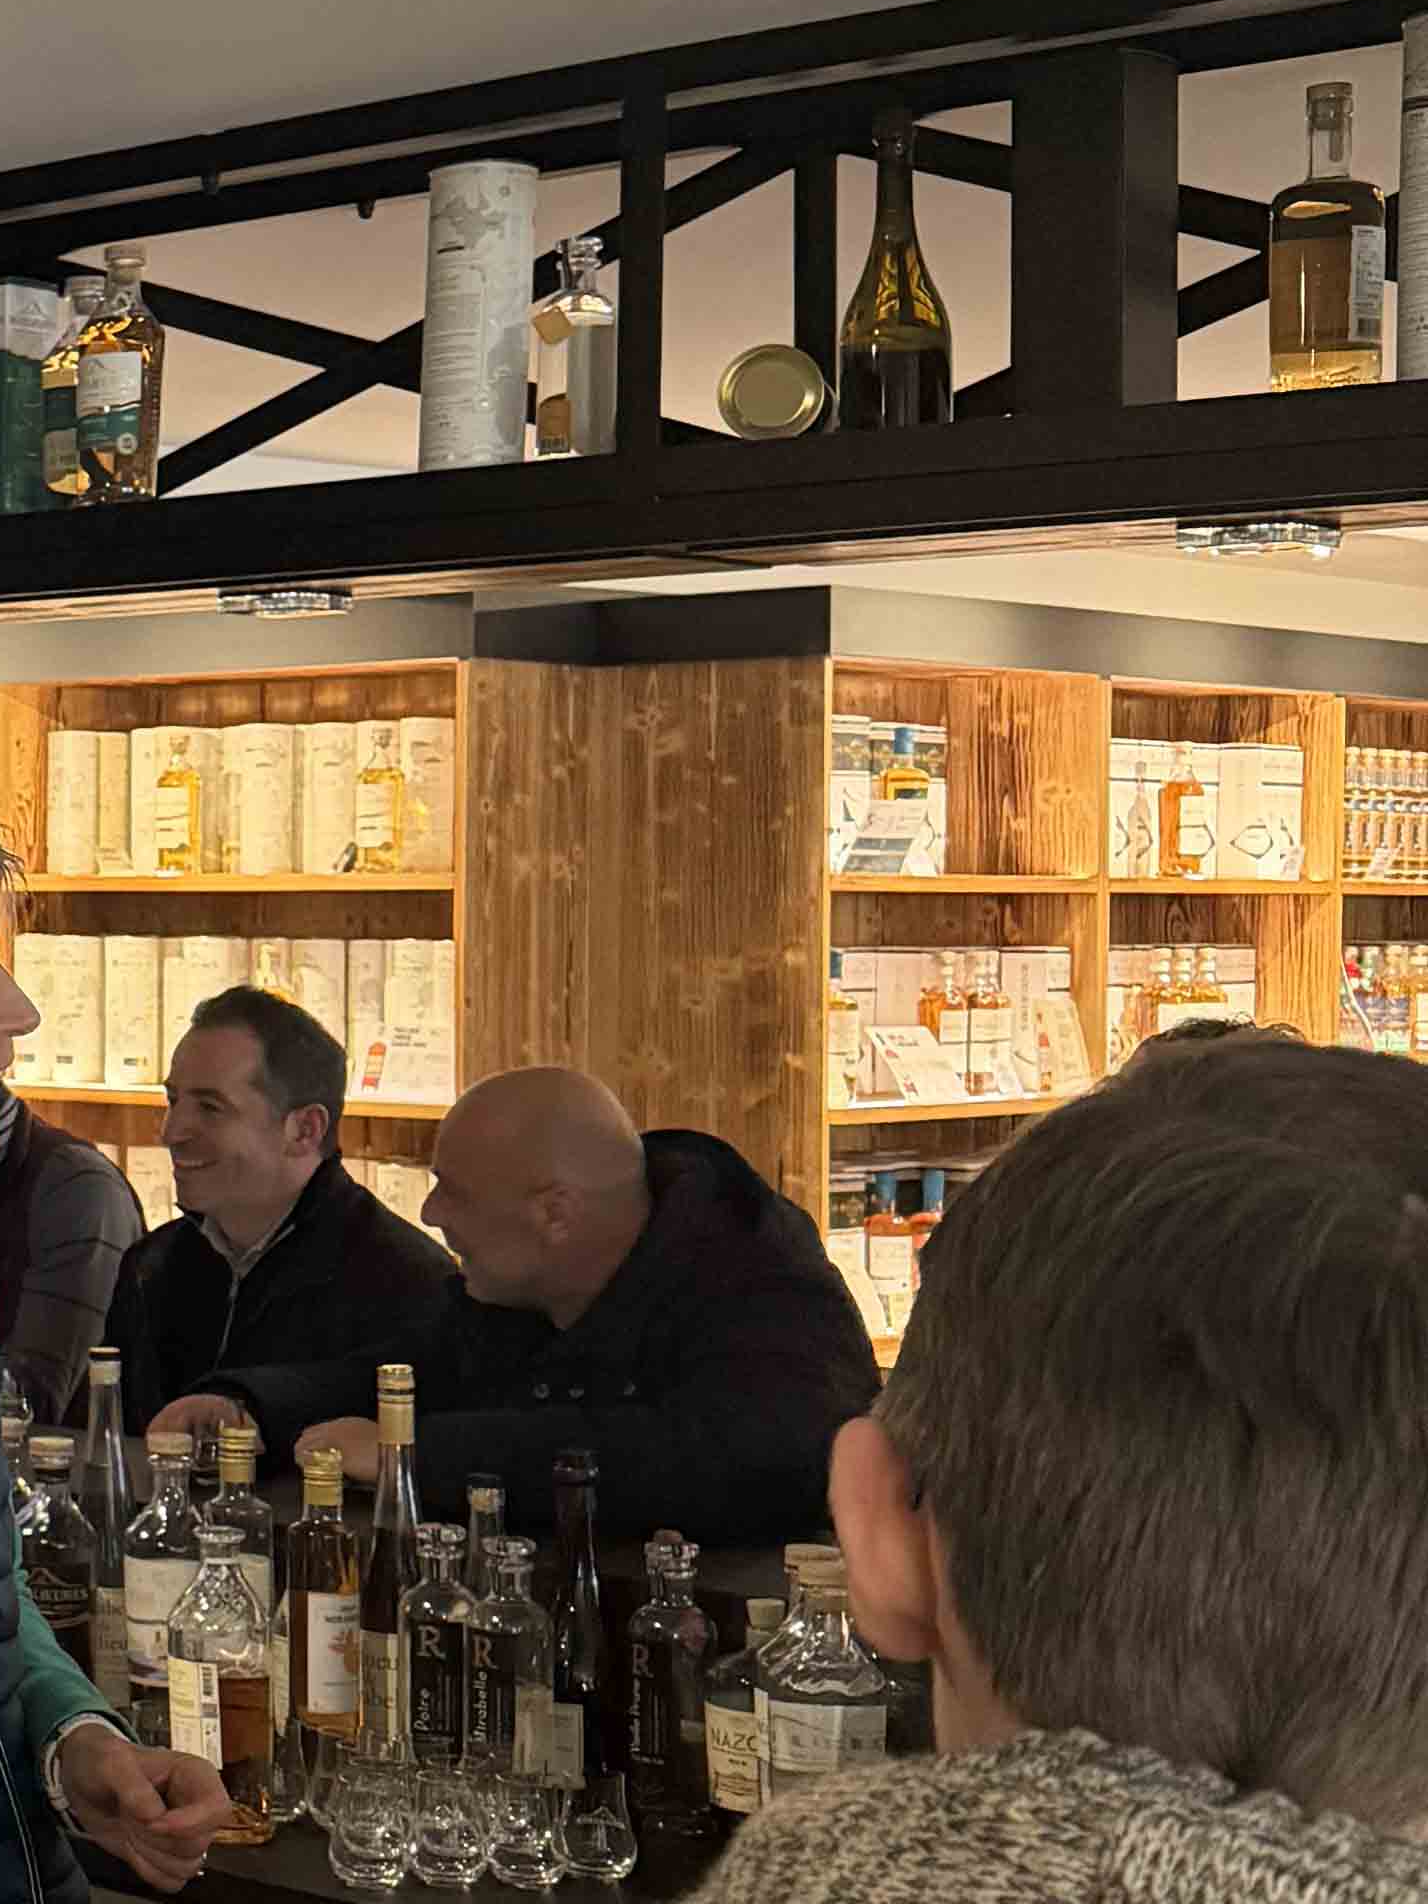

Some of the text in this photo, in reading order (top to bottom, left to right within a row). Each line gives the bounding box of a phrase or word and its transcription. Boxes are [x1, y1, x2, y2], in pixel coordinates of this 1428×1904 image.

[416, 1624, 447, 1660] R
[473, 1635, 500, 1670] R
[413, 1687, 432, 1732] Poire
